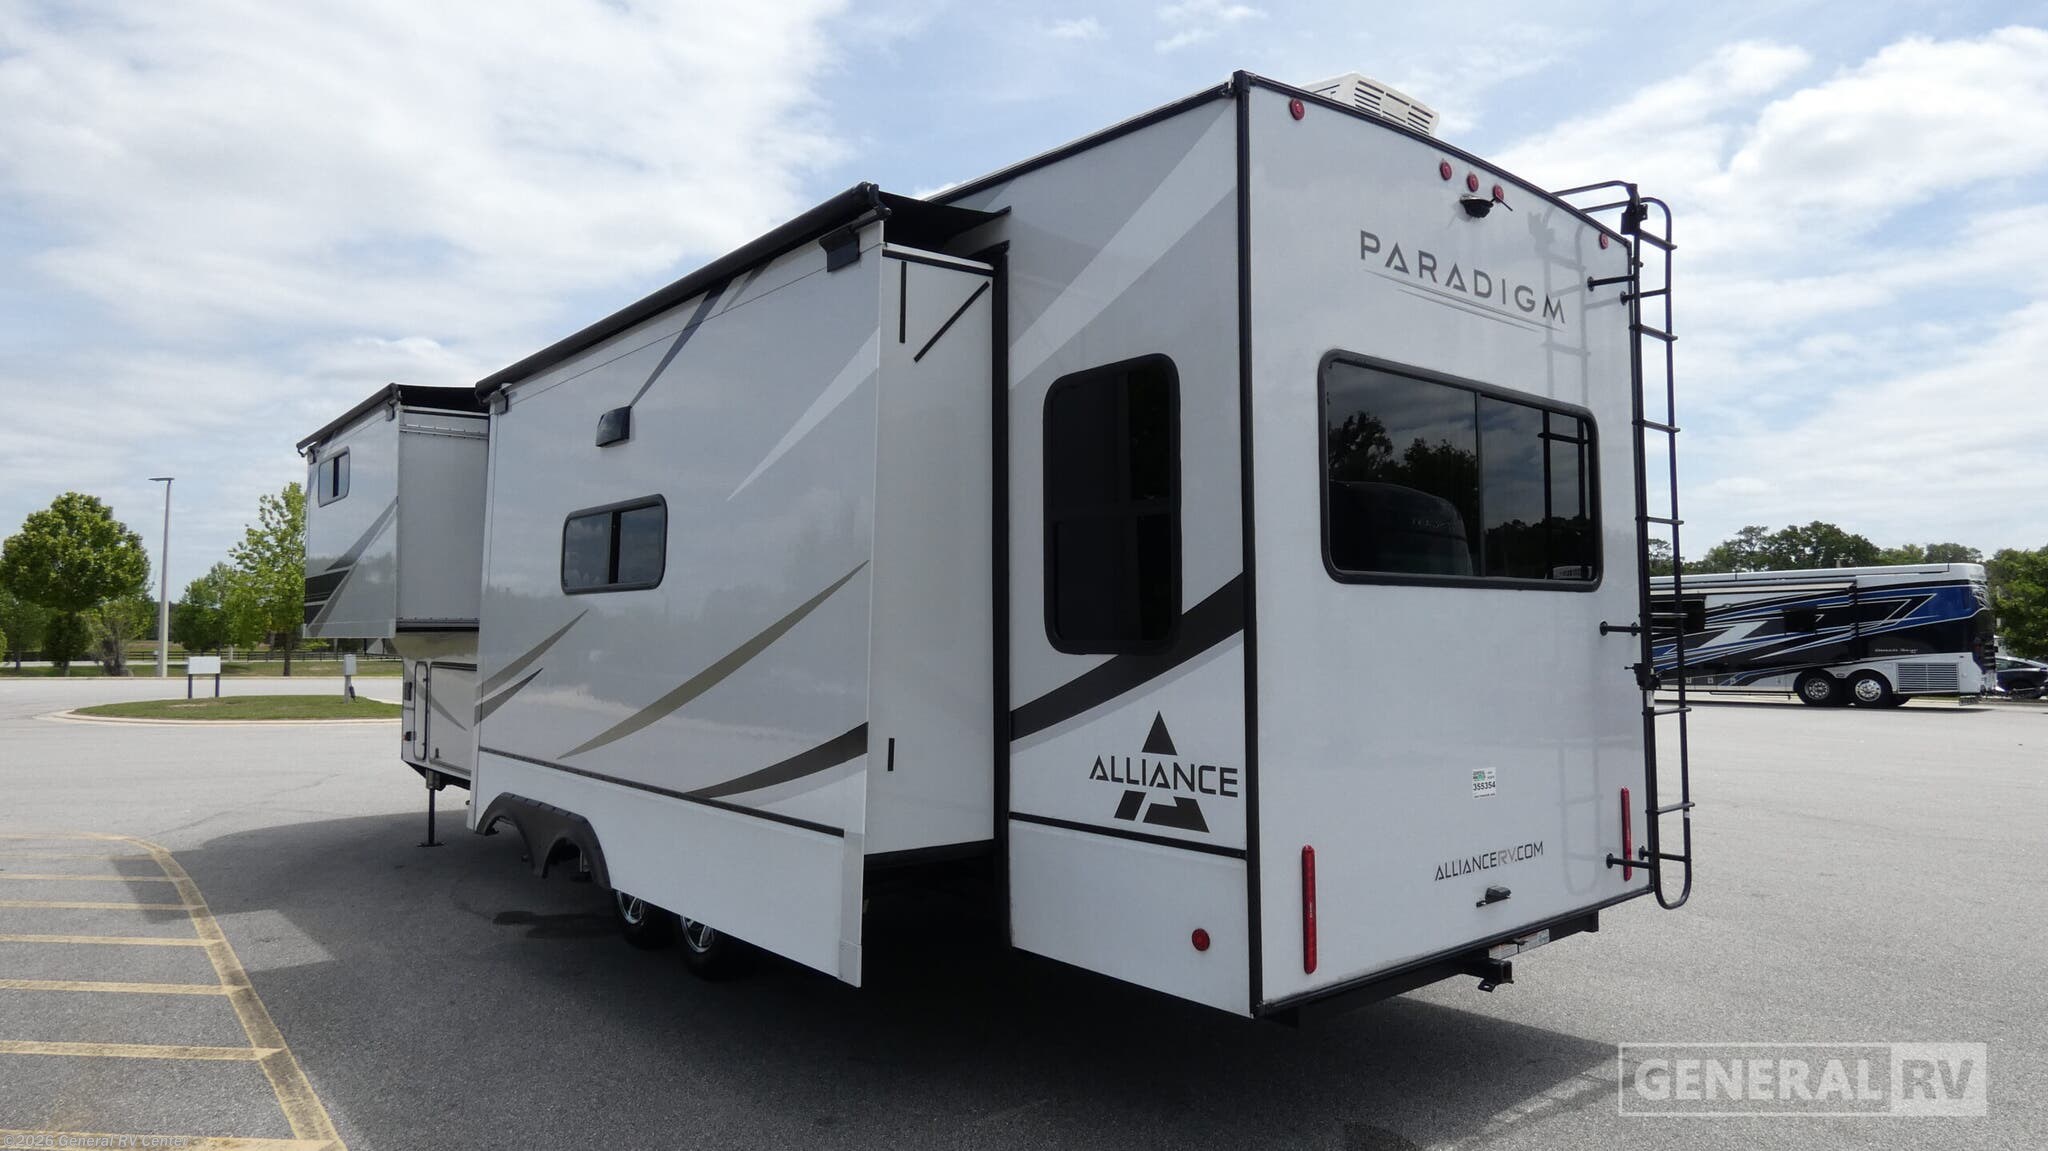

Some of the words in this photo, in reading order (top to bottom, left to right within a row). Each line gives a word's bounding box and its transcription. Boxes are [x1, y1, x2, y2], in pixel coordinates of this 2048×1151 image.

[1360, 230, 1566, 324] PARADIGM
[1089, 755, 1239, 798] ALLIANCE
[1472, 781, 1496, 791] 355354
[1434, 841, 1545, 881] ALLIANCERV.COM
